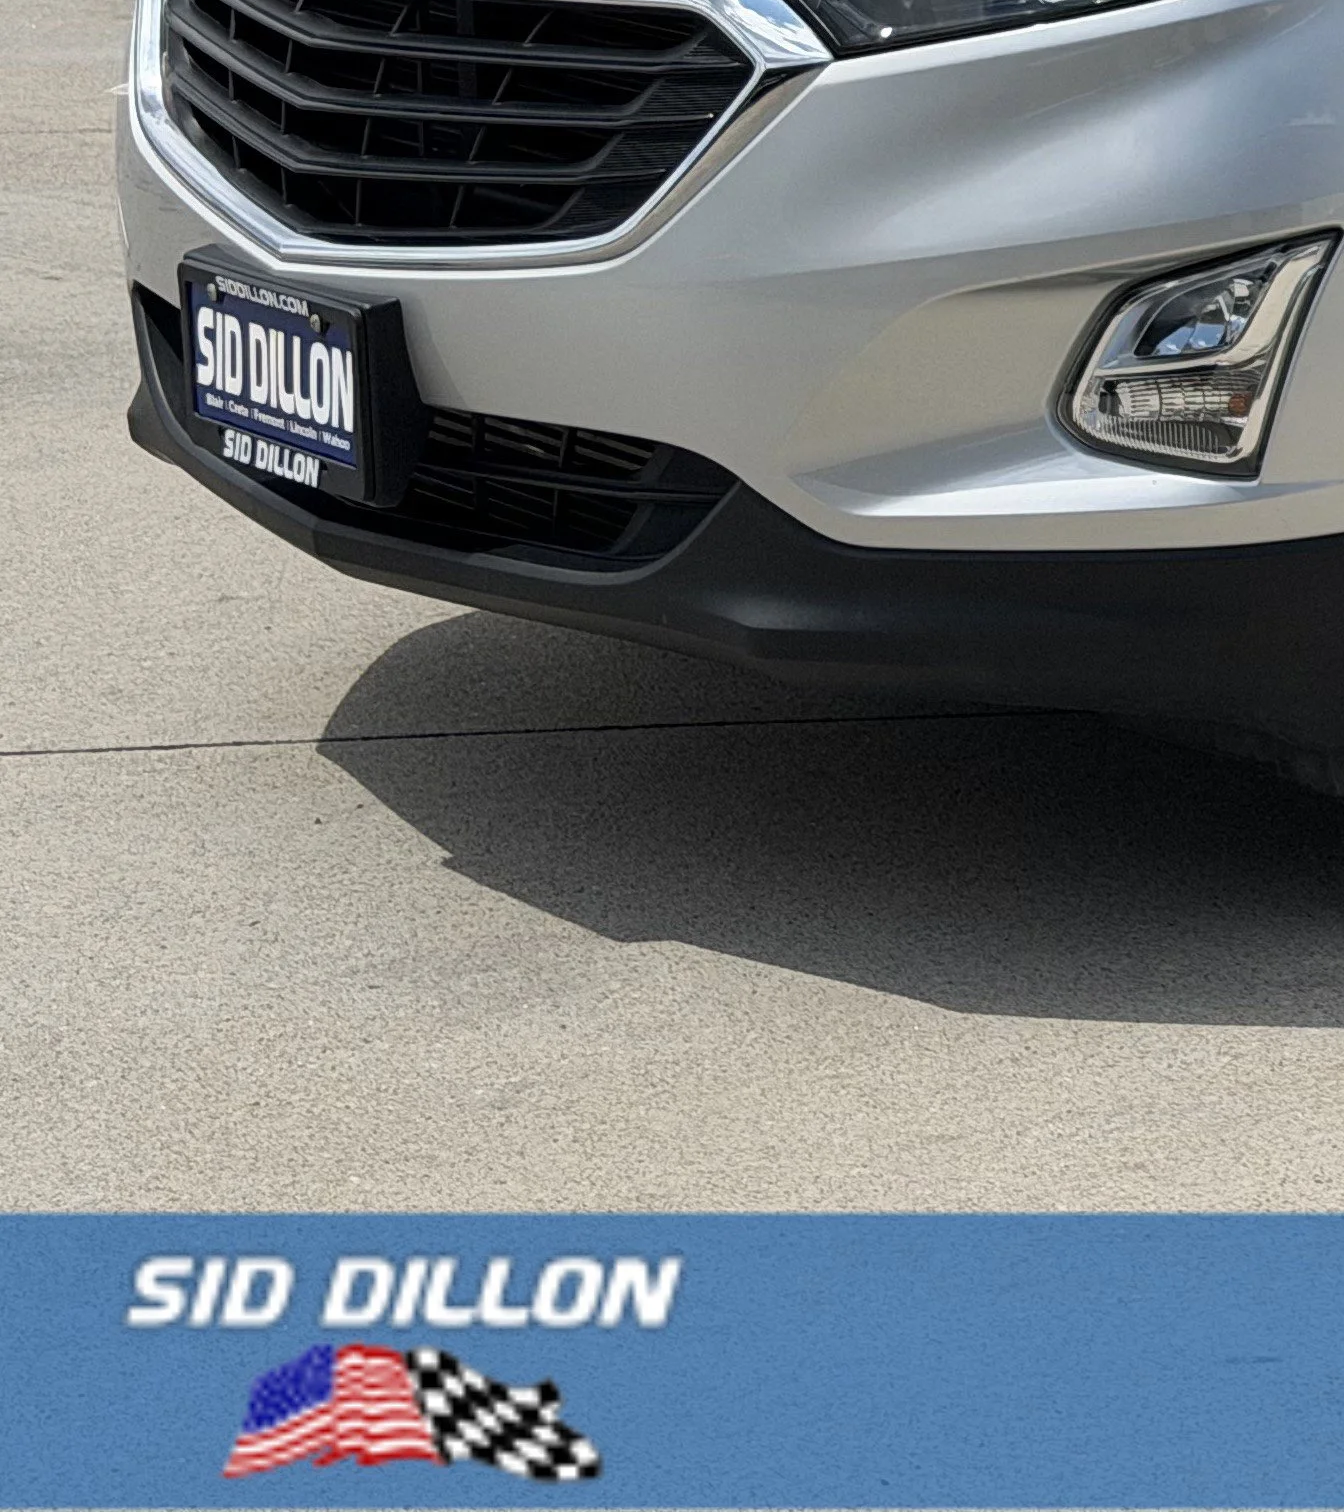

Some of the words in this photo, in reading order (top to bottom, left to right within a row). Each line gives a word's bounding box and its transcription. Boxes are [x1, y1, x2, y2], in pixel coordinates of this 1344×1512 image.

[215, 276, 309, 317] SIDDILLON.COM
[196, 306, 243, 397] SID
[248, 322, 354, 433] DILLON
[223, 429, 252, 465] SID
[255, 438, 320, 488] DILLON
